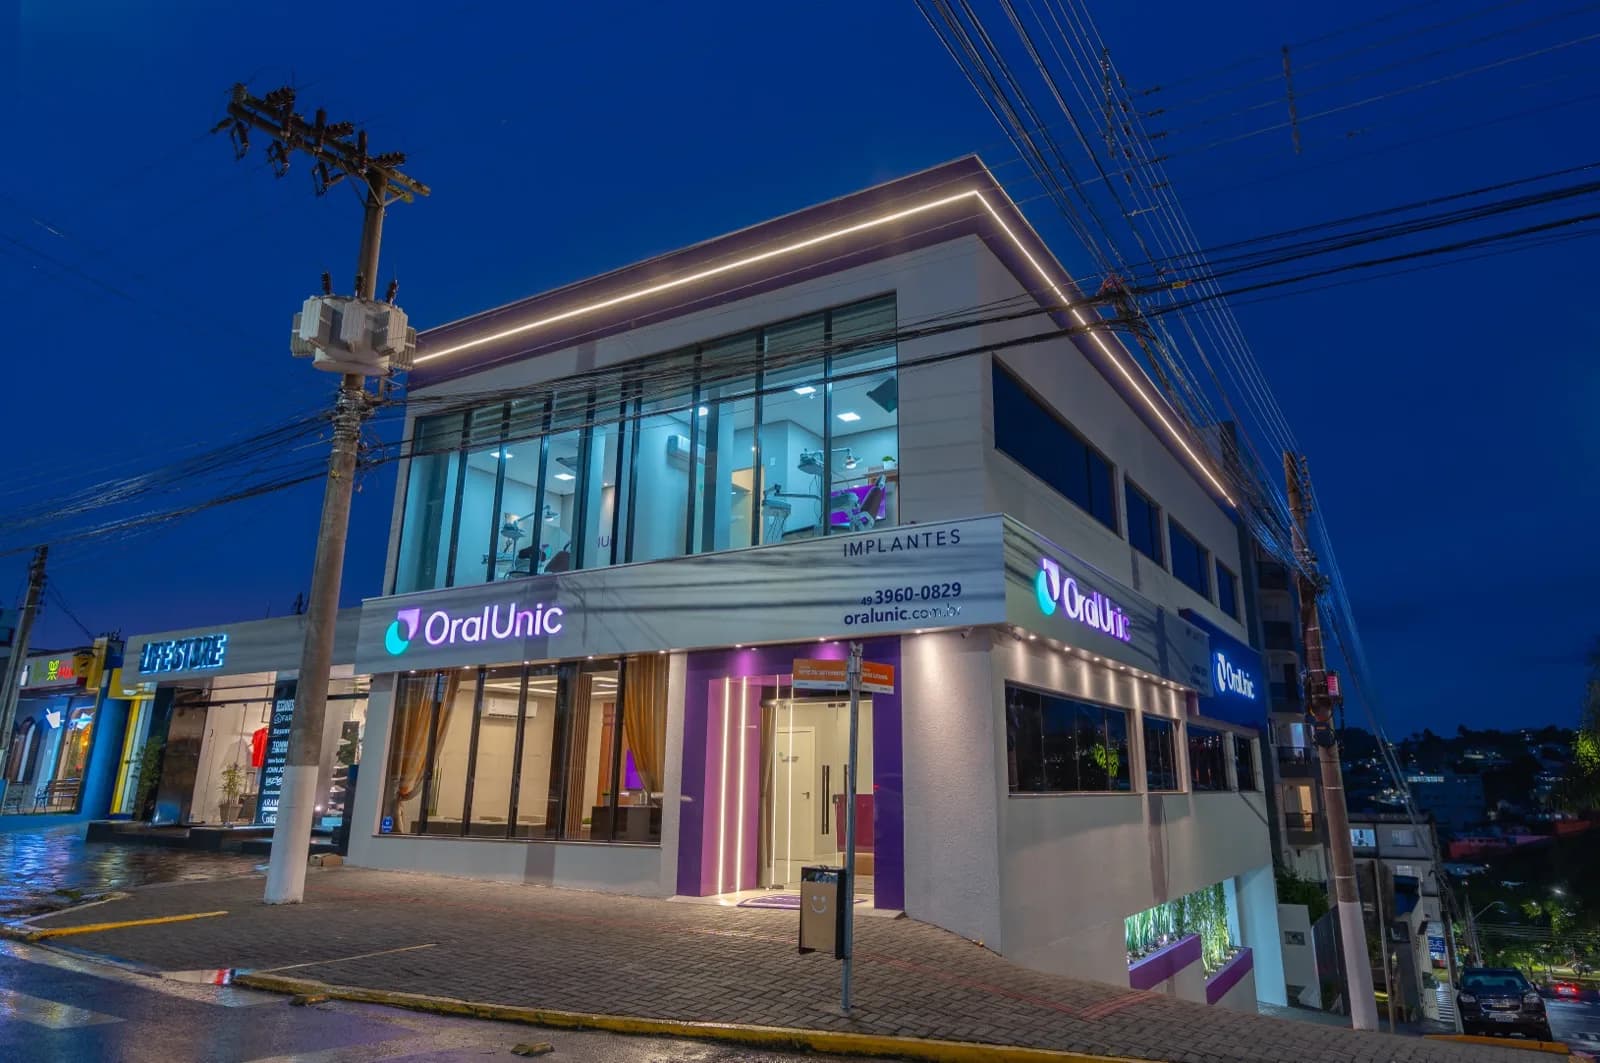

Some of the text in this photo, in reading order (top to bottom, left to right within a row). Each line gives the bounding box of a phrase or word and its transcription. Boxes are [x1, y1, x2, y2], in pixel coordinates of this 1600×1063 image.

[844, 529, 960, 558] IMPLANTES
[861, 582, 962, 606] 49 3960-0829
[425, 602, 564, 645] OralUnic
[844, 603, 962, 625] oralunic.com.br
[1063, 577, 1131, 642] OralUnic
